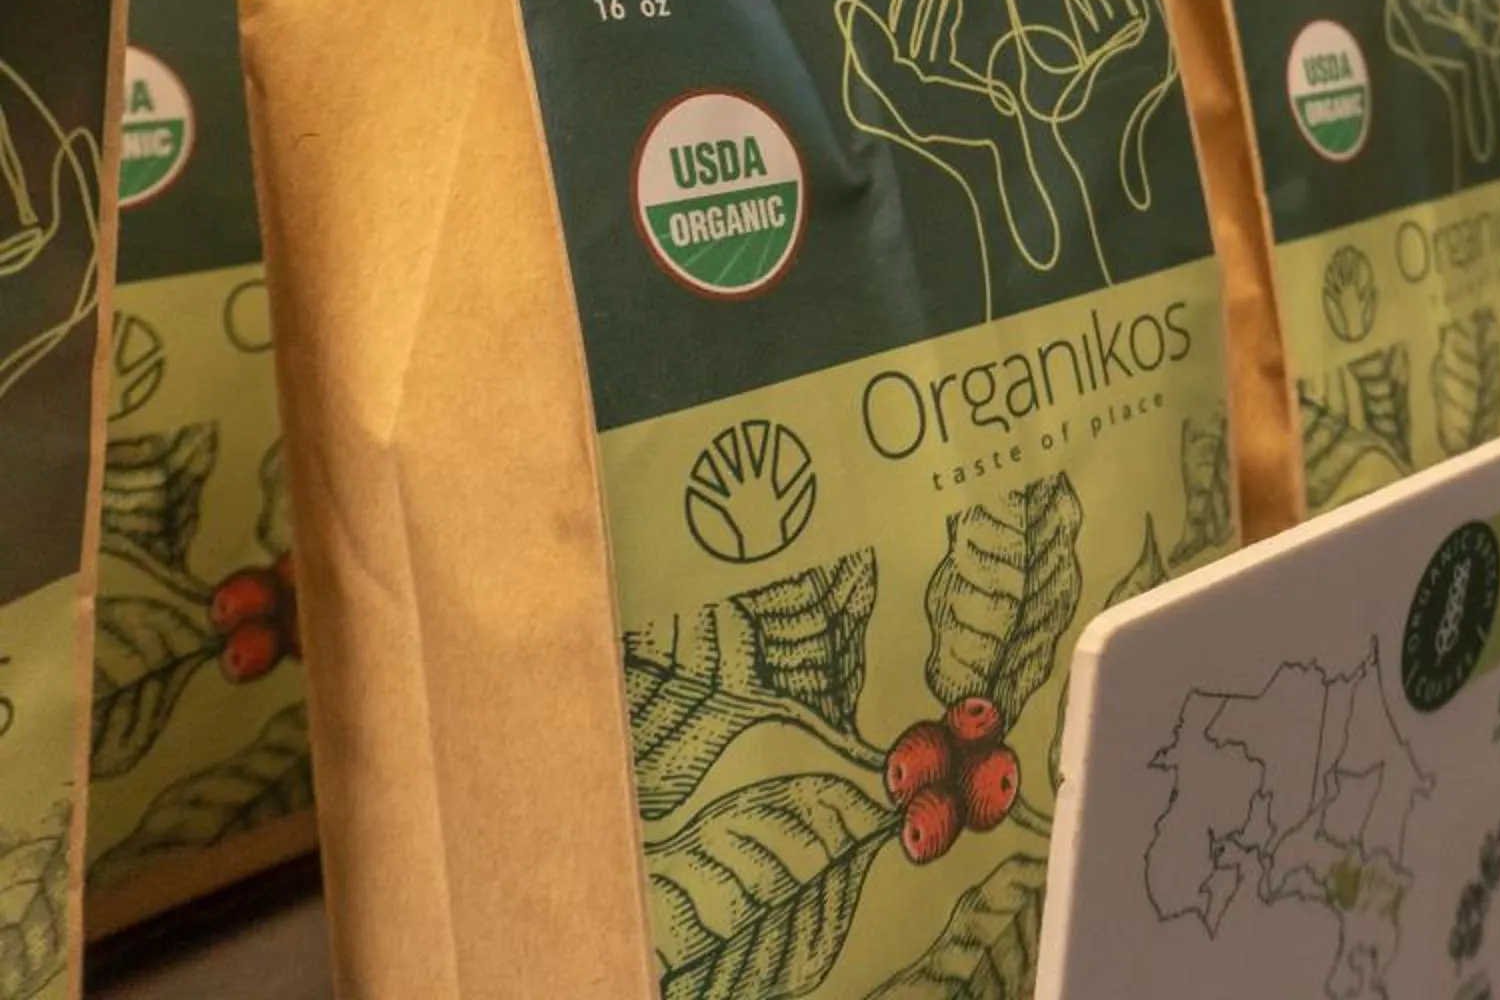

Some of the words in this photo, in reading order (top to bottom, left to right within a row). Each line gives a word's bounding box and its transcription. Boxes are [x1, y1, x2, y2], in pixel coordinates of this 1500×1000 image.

[668, 135, 768, 190] USDA
[667, 193, 787, 249] ORGANIC
[861, 301, 1192, 460] Organikos
[932, 444, 1023, 492] taste
[1040, 421, 1071, 451] of
[1089, 390, 1166, 439] place
